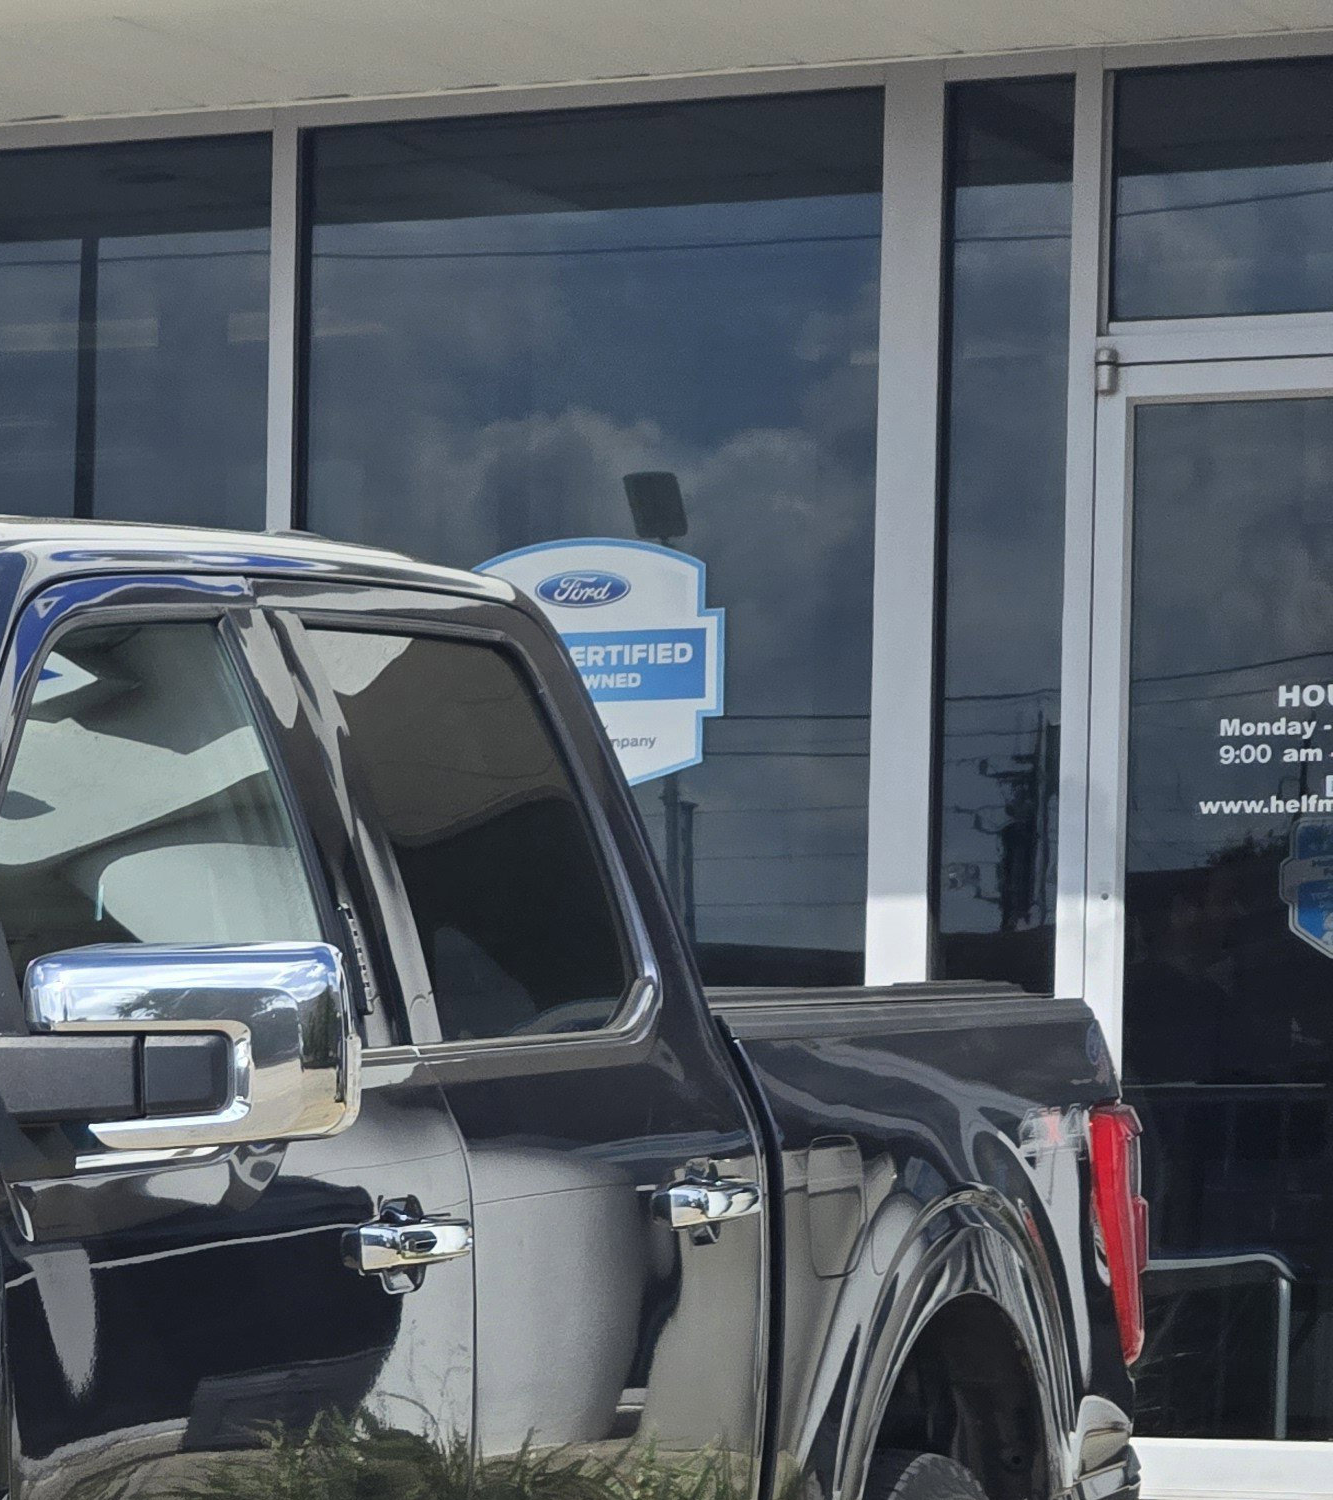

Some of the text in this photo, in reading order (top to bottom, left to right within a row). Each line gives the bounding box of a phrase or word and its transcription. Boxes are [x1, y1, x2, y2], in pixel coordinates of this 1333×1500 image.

[554, 577, 612, 601] Ford
[569, 643, 694, 668] ERTIFIED
[582, 672, 642, 690] WNED
[1278, 684, 1333, 707] HO
[1220, 717, 1317, 739] Monday
[1219, 743, 1323, 764] 9:00 am
